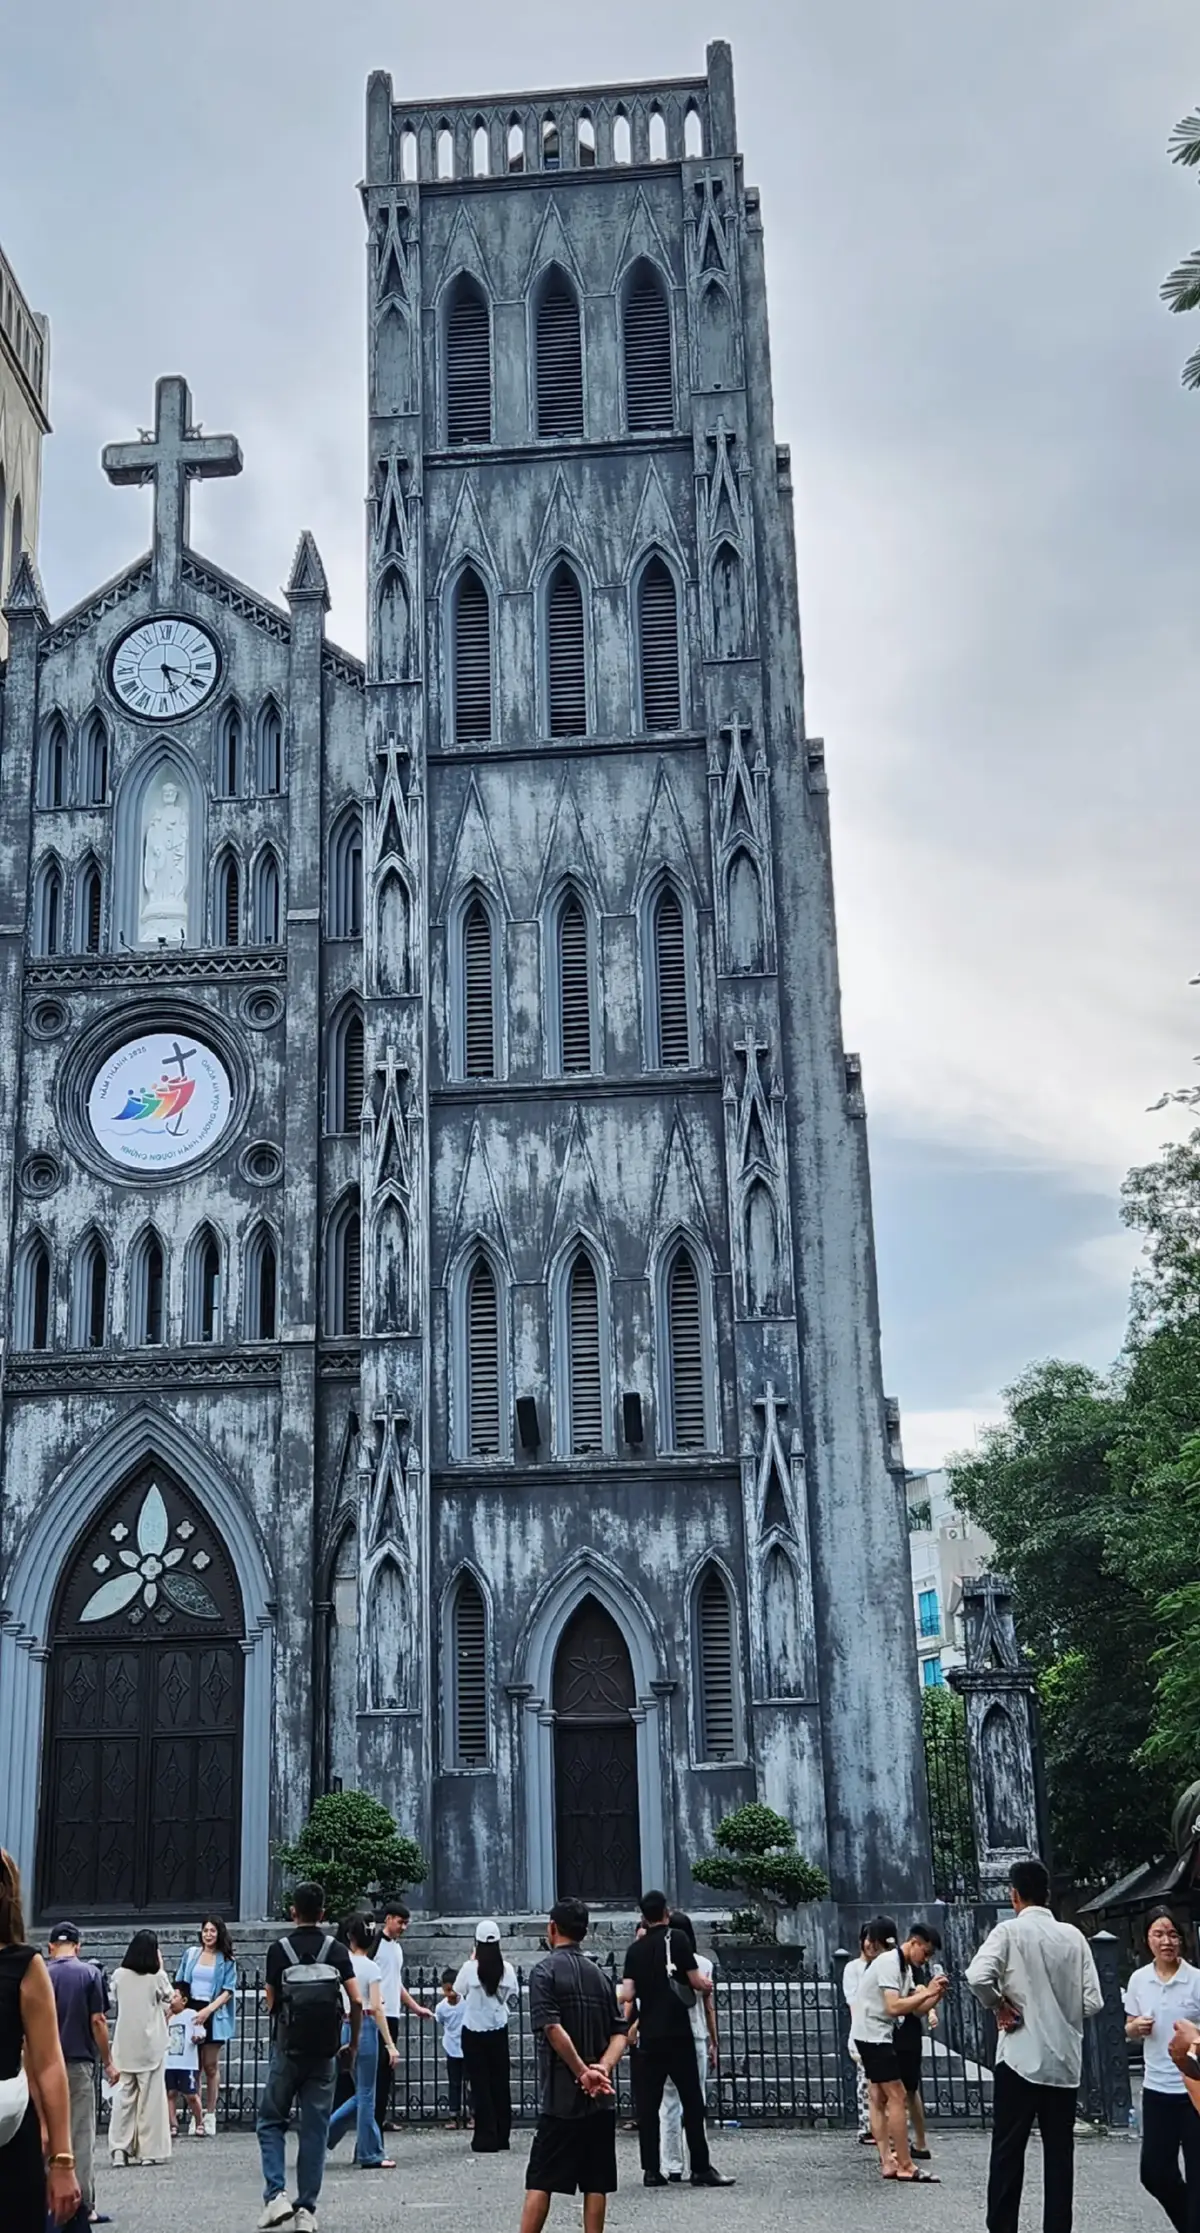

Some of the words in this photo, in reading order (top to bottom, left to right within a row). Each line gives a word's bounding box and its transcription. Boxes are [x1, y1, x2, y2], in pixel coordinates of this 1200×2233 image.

[138, 630, 153, 645] XI
[159, 624, 173, 640] XII
[180, 629, 190, 643] I
[123, 646, 140, 658] X
[191, 643, 207, 653] II
[117, 665, 134, 675] IX
[195, 662, 212, 670] III
[120, 680, 139, 697] VIII
[135, 692, 151, 710] VII
[158, 697, 168, 712] VI
[128, 1046, 147, 1059] 2025
[211, 1094, 220, 1111] CỦA
